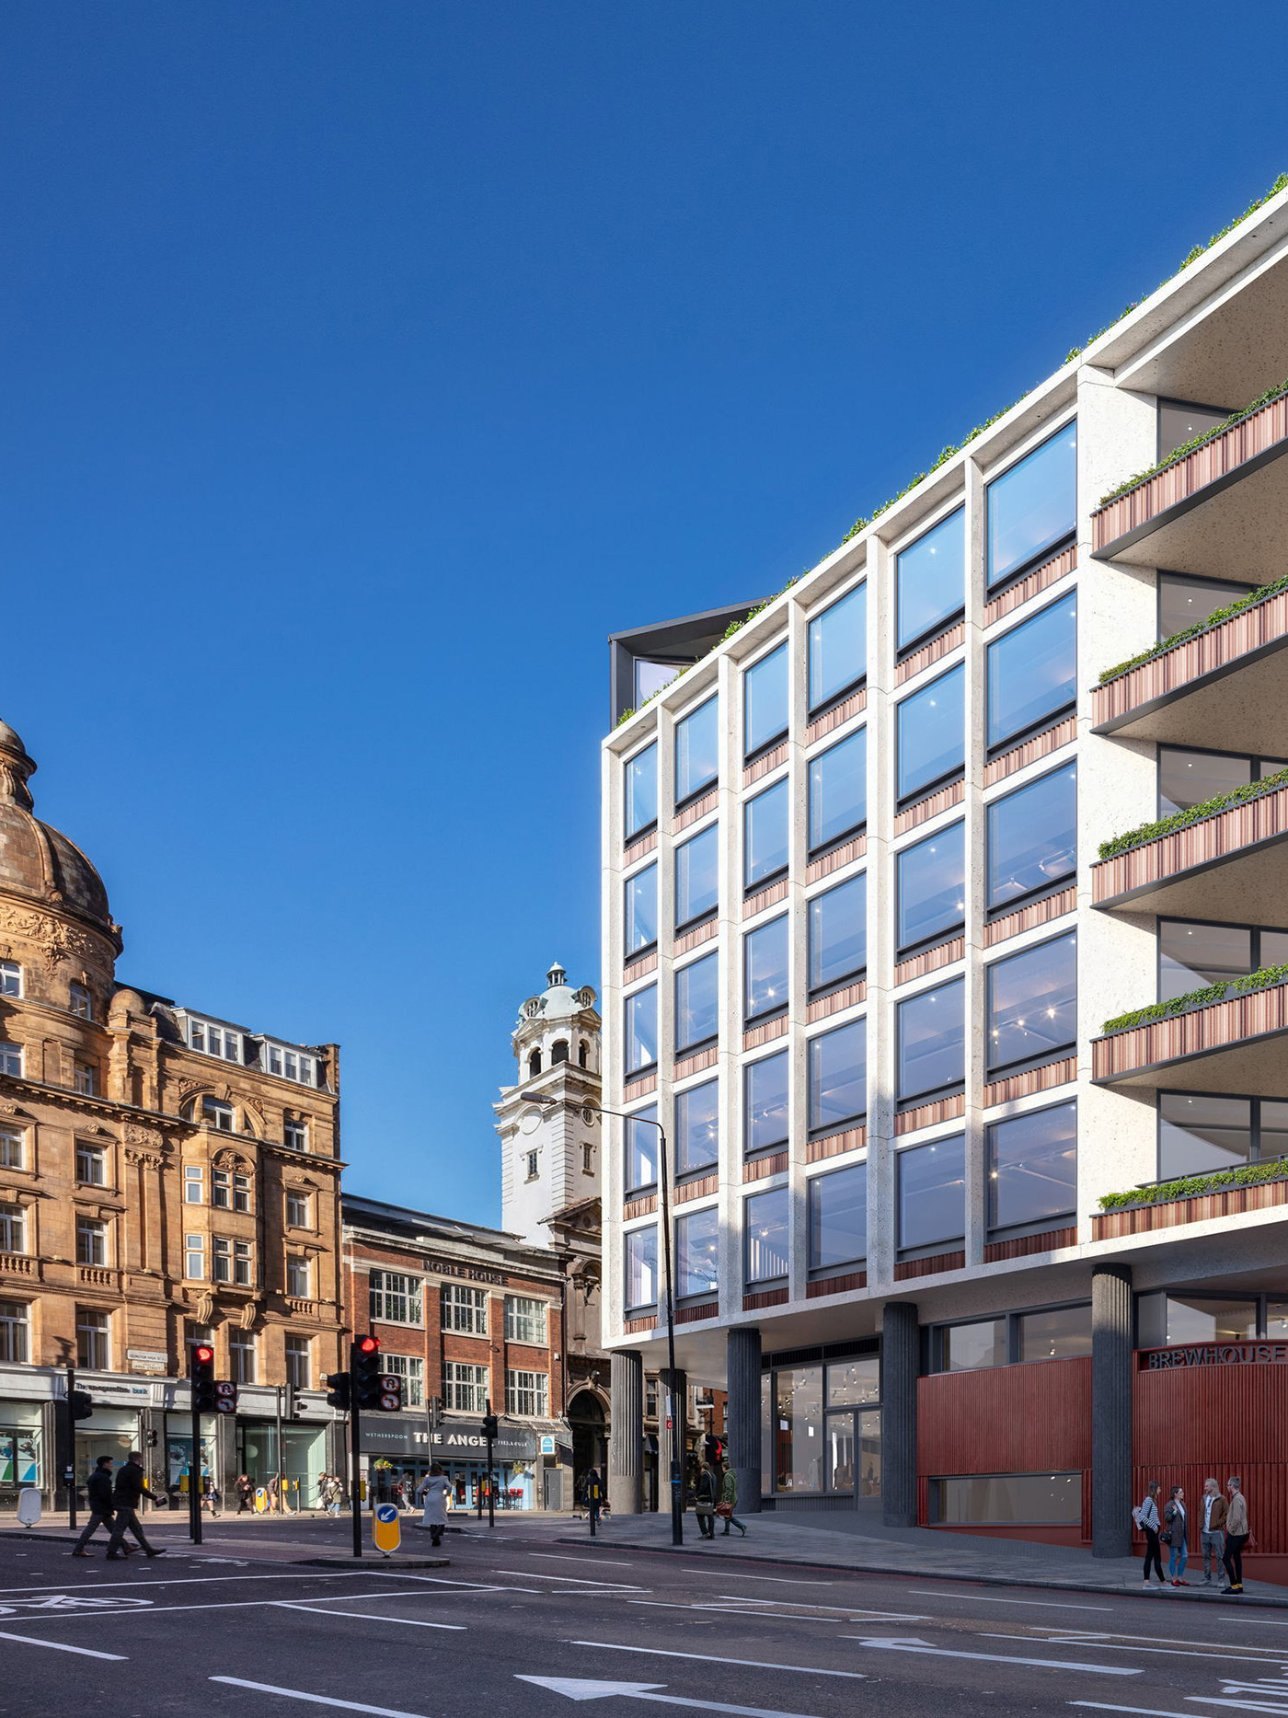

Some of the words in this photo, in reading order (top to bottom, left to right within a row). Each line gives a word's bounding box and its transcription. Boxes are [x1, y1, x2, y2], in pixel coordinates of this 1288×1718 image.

[466, 1269, 509, 1286] HOUSE
[1148, 1346, 1287, 1370] BREWHOUSE
[413, 1432, 442, 1444] THE
[447, 1434, 494, 1447] ANGE
